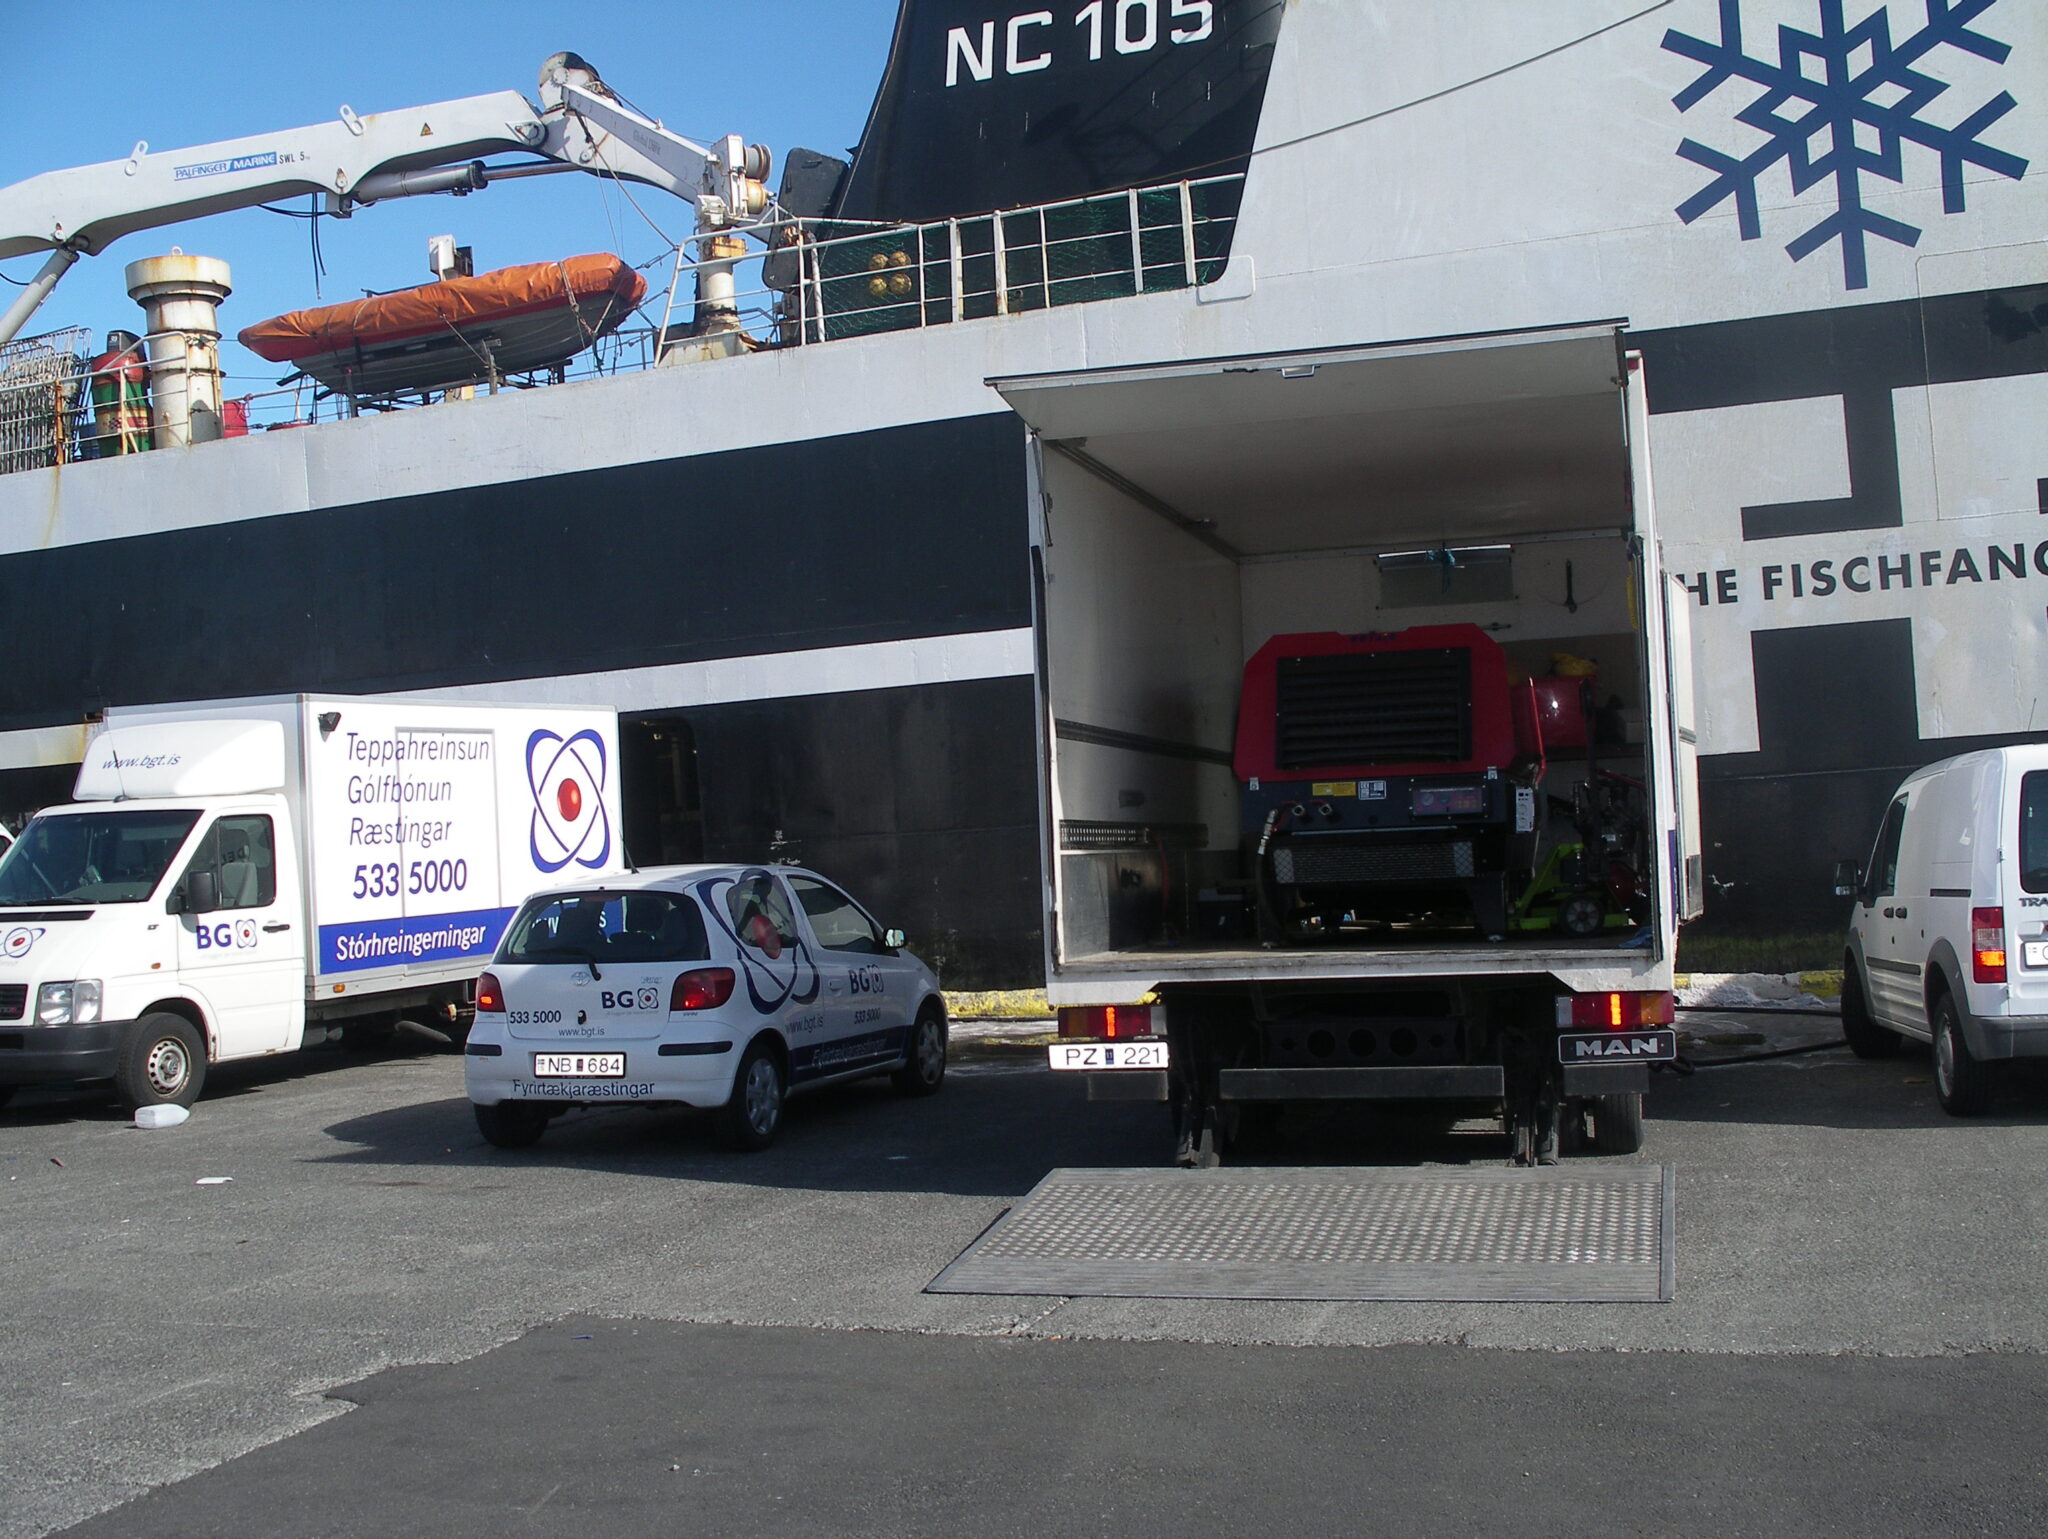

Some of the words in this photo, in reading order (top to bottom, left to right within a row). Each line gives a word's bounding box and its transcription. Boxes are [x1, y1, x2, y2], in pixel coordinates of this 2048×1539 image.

[945, 10, 1053, 87] NC
[1075, 0, 1213, 61] 105
[175, 162, 227, 179] PALFINGER
[233, 153, 276, 169] MARINE
[279, 153, 296, 165] SWL
[347, 732, 490, 767] Teppahreinsun
[102, 754, 181, 769] www.bgt.is
[348, 773, 452, 804] Gólfbónun
[349, 816, 453, 848] Ræstingar
[352, 863, 400, 899] 533
[408, 858, 468, 895] 5000
[196, 923, 232, 949] BG
[336, 924, 487, 961] Stórhreingerningar
[848, 967, 870, 994] BG
[601, 990, 634, 1009] BG
[510, 1011, 530, 1024] 533
[532, 1010, 562, 1024] 5000
[558, 1026, 605, 1038] www.bgt.is
[1065, 1048, 1098, 1066] PZ
[1124, 1047, 1160, 1065] 221
[1575, 1038, 1658, 1056] MAN
[548, 1058, 571, 1073] NB
[588, 1058, 620, 1073] 684
[512, 1079, 656, 1099] Fyrirtækjaræstingar
